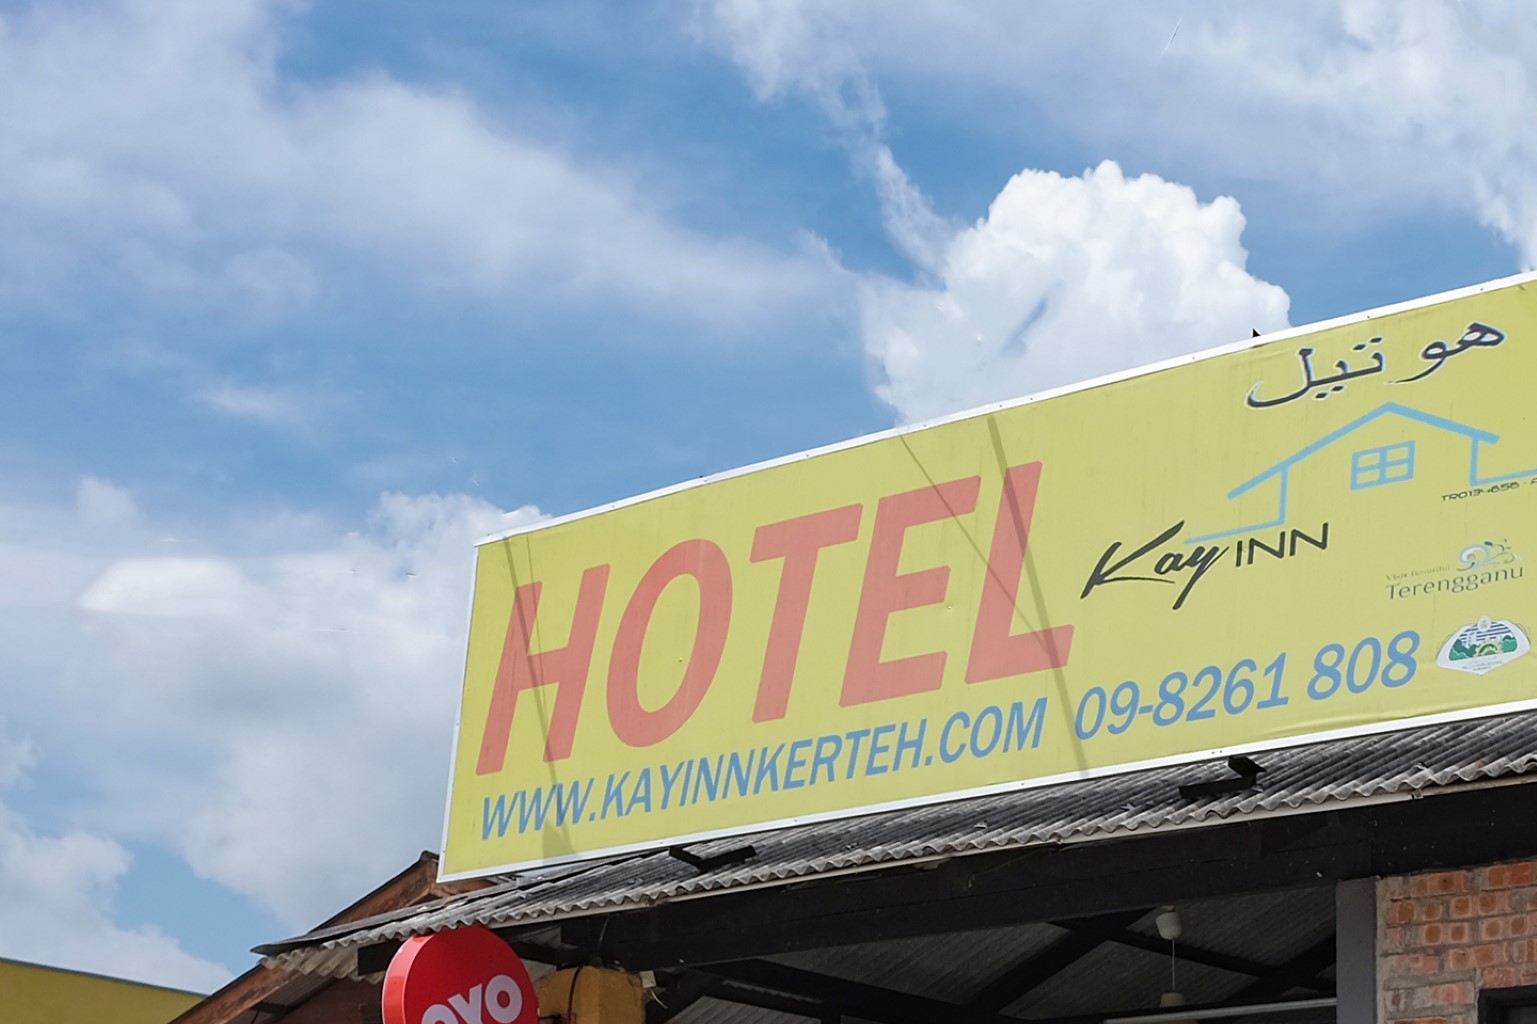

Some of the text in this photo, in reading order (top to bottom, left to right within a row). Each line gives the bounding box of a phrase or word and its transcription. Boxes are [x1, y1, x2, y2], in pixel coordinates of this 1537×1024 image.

[475, 461, 1075, 776] HOTEL
[1080, 519, 1329, 611] Kay INN
[1386, 566, 1523, 600] Terengganu
[481, 630, 1421, 840] WWW.KAYINNKERTEH.COM 09-8261 808
